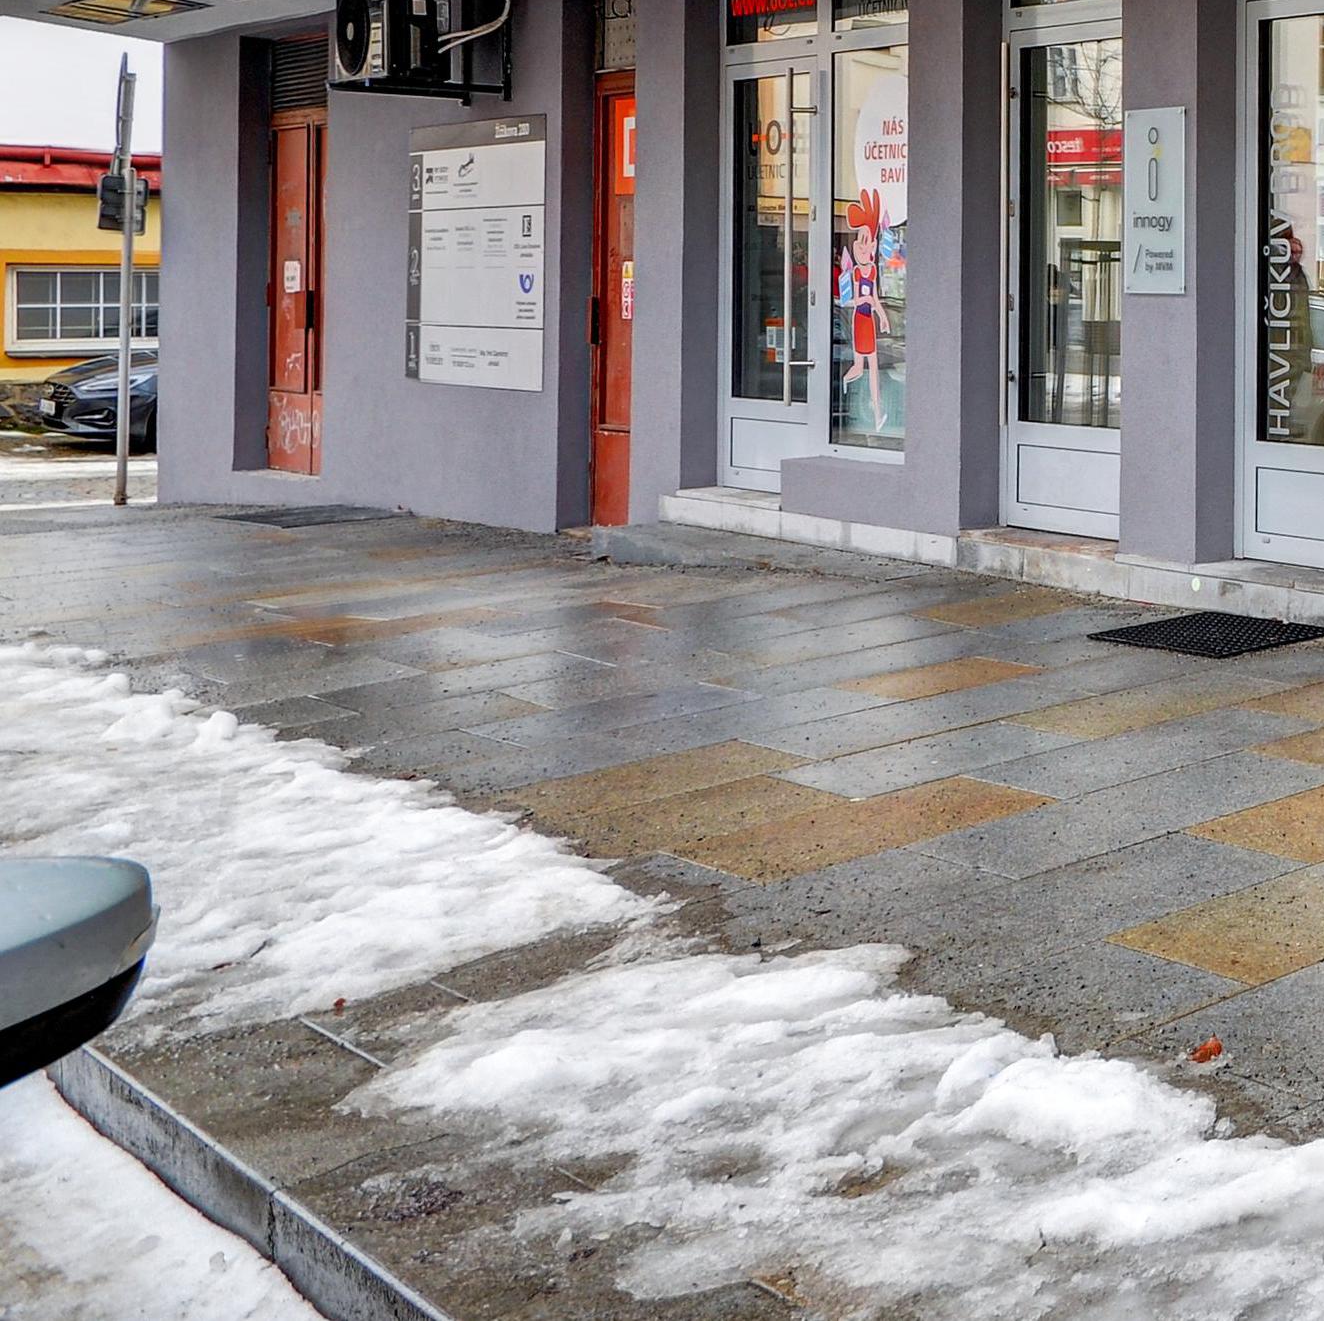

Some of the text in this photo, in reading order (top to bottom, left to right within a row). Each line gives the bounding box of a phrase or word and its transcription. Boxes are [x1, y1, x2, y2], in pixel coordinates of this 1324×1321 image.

[882, 115, 904, 136] NÁS
[880, 163, 905, 184] BAVÍ
[1132, 211, 1174, 232] innogy
[1145, 248, 1174, 259] Powered
[1145, 262, 1153, 273] by
[1263, 209, 1292, 437] HAVLÍČKŮV
